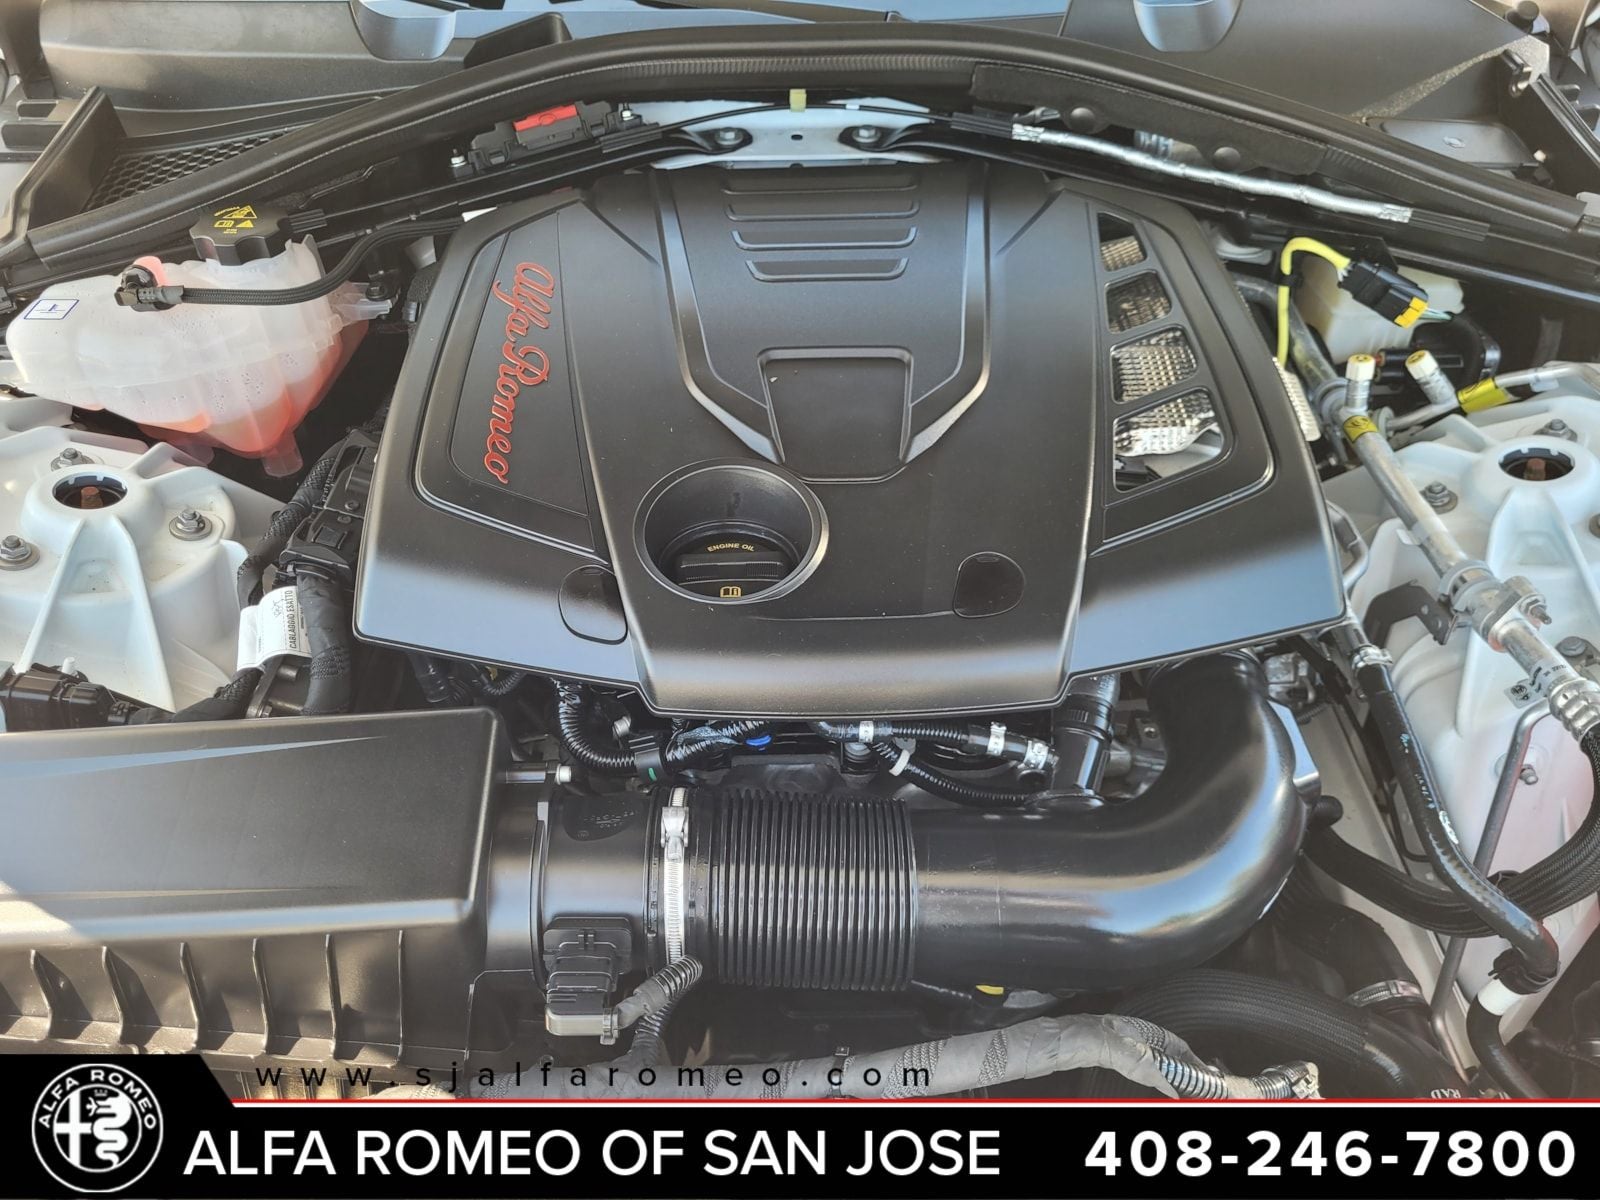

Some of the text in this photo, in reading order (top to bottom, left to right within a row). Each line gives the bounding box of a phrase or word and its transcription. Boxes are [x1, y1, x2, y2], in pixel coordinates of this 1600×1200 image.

[484, 262, 554, 484] Alfa Romeo
[707, 543, 755, 552] ENGINE OIL
[285, 590, 295, 614] ESATTO
